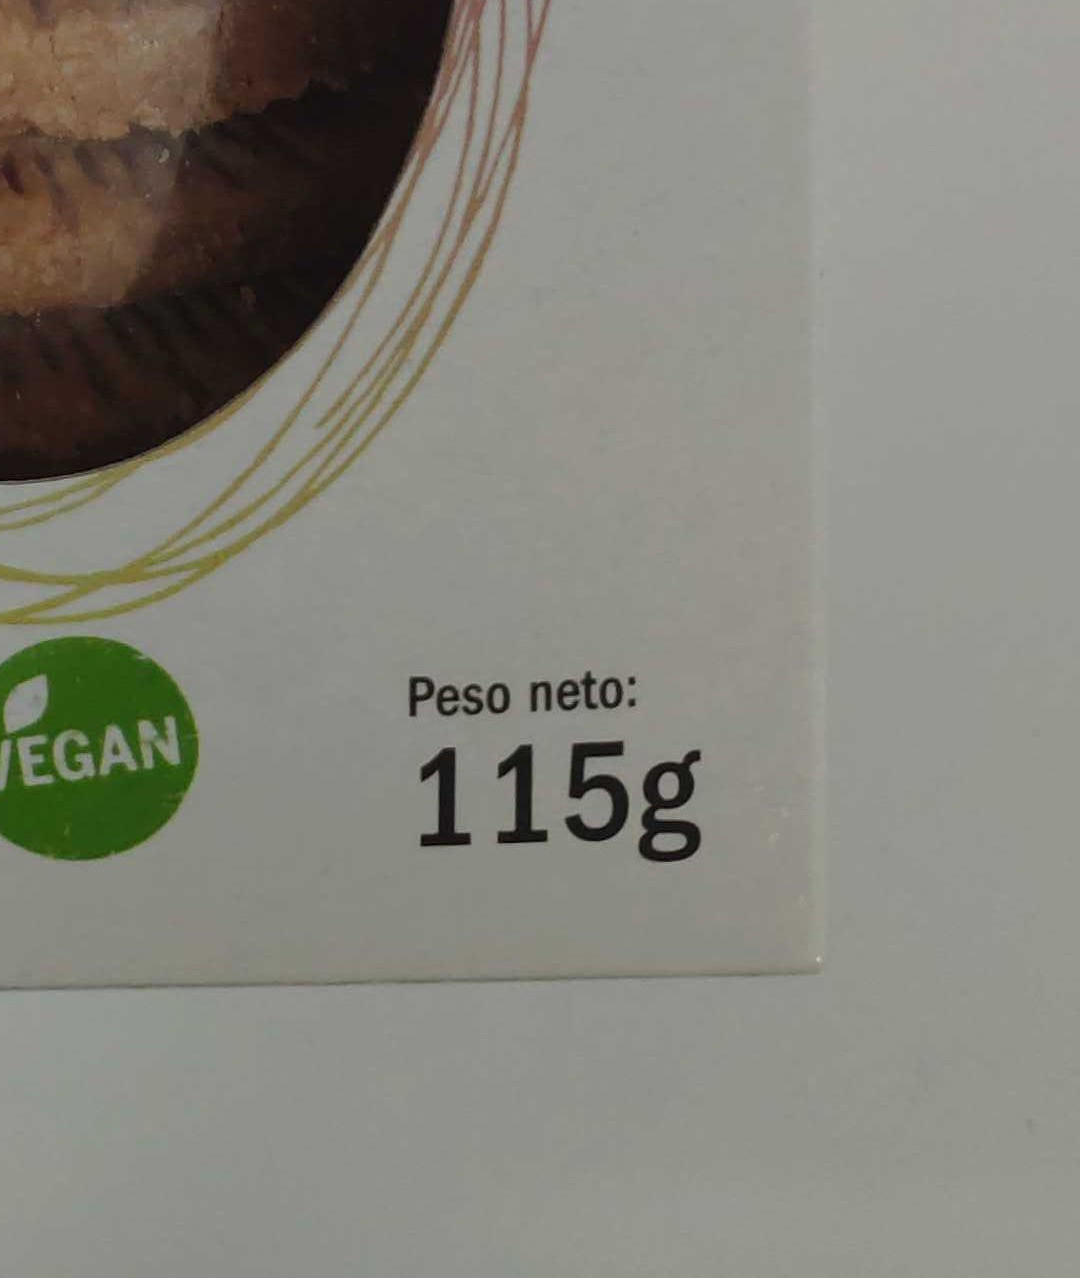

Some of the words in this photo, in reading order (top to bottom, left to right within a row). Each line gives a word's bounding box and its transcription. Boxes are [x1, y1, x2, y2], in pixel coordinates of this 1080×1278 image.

[408, 675, 511, 717] Peso
[529, 670, 637, 712] neto:
[418, 740, 702, 863] 115g
